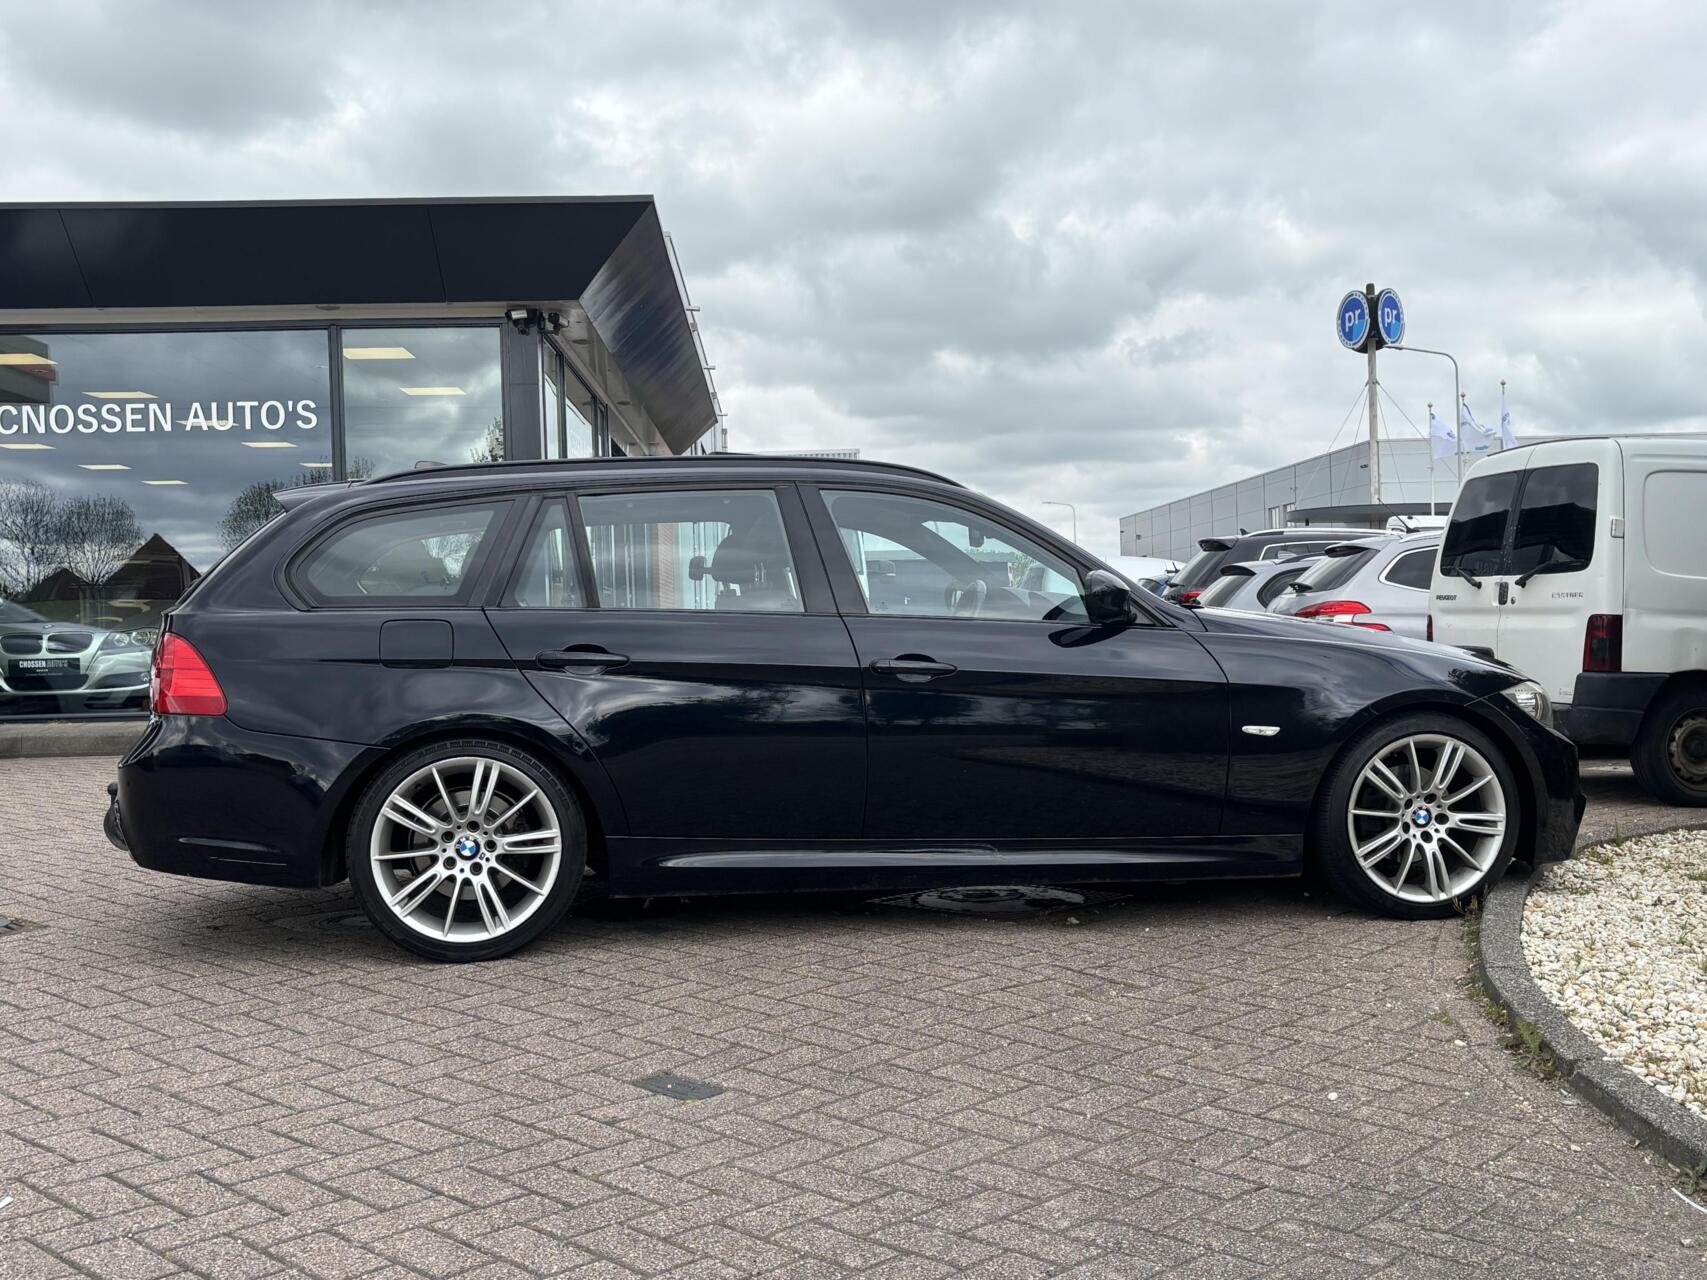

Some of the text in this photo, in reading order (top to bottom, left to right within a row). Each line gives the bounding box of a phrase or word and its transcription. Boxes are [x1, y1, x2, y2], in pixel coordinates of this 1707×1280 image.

[1345, 308, 1361, 333] pr
[1384, 307, 1397, 328] pr
[0, 400, 318, 435] CNOSSEN AUTO'S
